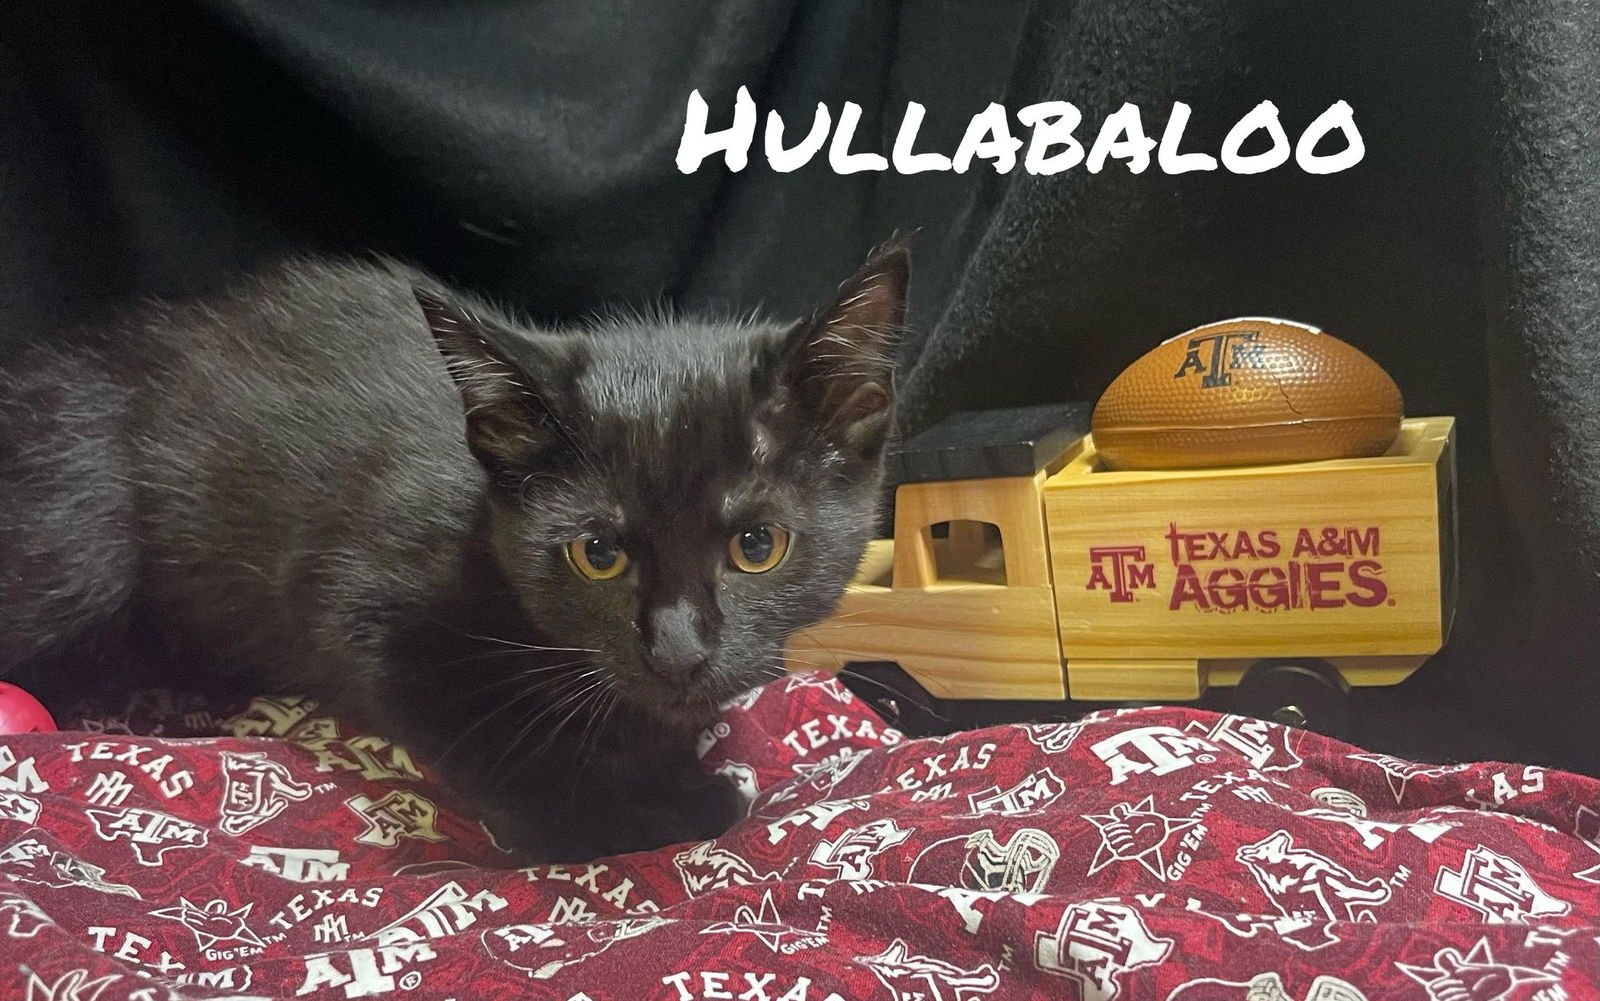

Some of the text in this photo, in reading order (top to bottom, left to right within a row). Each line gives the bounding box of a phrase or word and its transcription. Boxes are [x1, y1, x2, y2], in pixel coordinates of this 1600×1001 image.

[1293, 526, 1381, 559] A&M
[782, 714, 902, 757] TEXAS
[61, 741, 196, 799] TEXAS
[877, 743, 997, 794] EXAS
[269, 887, 384, 930] TEXAS
